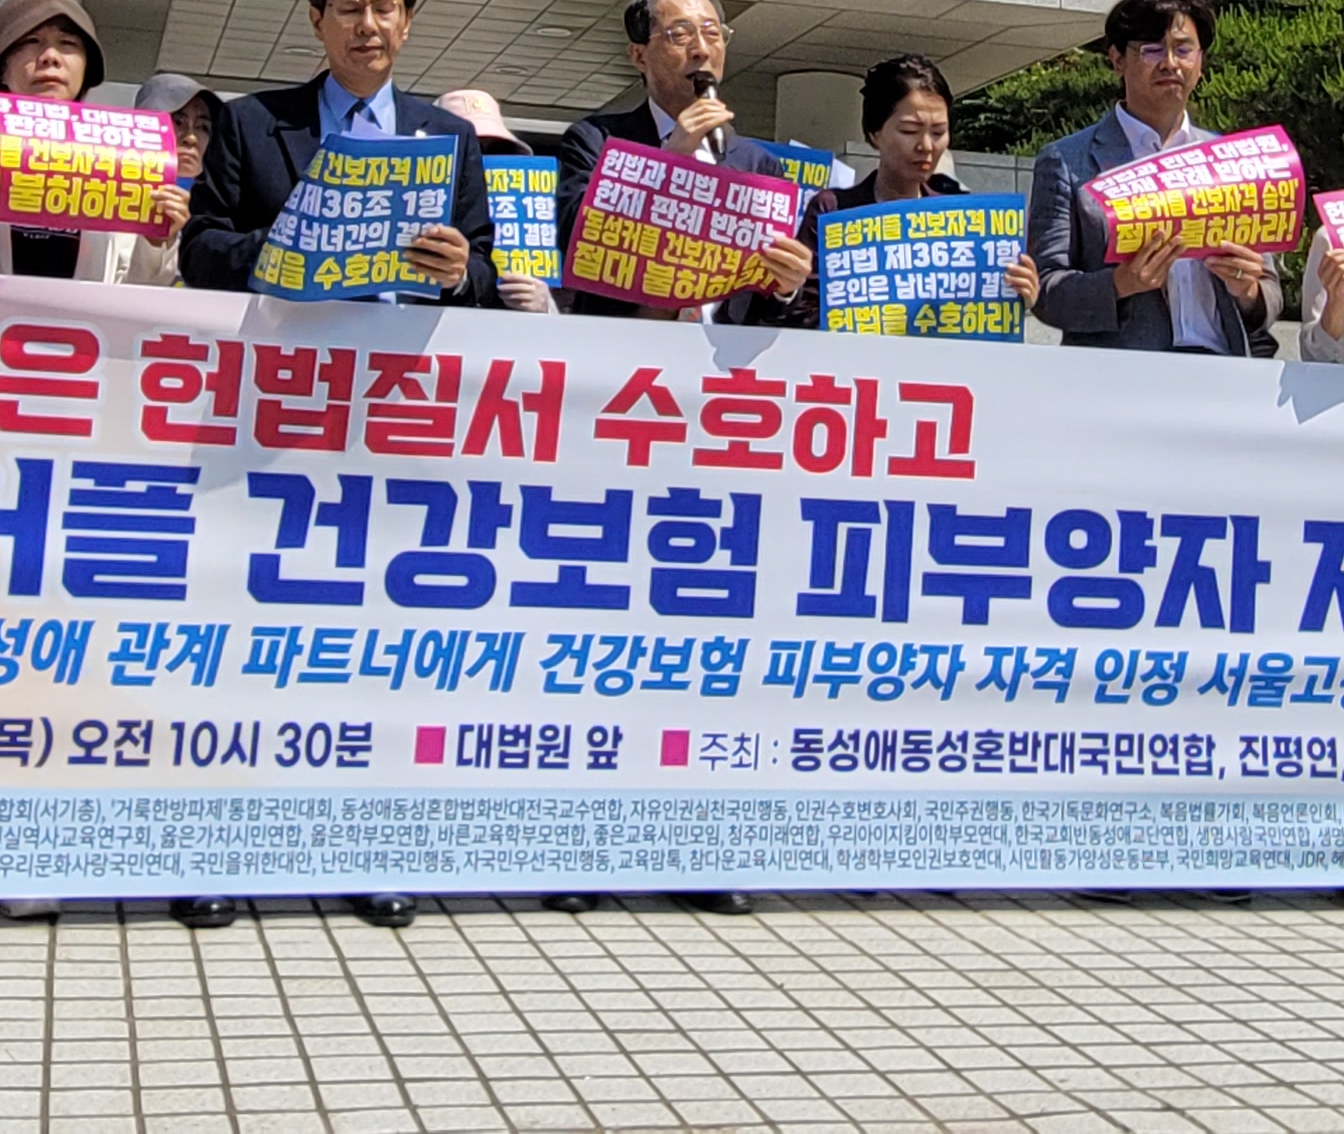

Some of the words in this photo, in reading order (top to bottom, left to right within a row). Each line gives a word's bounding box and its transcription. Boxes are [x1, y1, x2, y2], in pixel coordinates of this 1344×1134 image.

[4, 113, 66, 141] 판례
[74, 122, 163, 150] 반하는
[28, 138, 117, 181] 건보자격
[324, 152, 411, 187] 건보자격
[415, 155, 454, 185] NO!
[402, 189, 446, 217] 1항
[600, 148, 665, 191] 헌법과
[670, 166, 721, 207] 민법,
[725, 182, 793, 225] 대법원,
[593, 180, 647, 219] 헌재
[650, 194, 705, 235] 판례
[300, 219, 392, 252] 남녀간의
[825, 213, 901, 249] 동성커플
[906, 209, 986, 239] 건보자격
[991, 209, 1024, 237] NO!
[1180, 211, 1296, 248] 불허하라!
[663, 232, 743, 273] 건보자격
[825, 247, 878, 278] 헌법
[884, 241, 976, 270] 제36조
[982, 240, 1022, 267] 1항
[826, 275, 889, 306] 혼인은
[894, 272, 976, 300] 남녀간의
[828, 304, 907, 335] 헌법을
[914, 302, 1020, 334] 수호하라!
[138, 330, 568, 464] 헌법질서
[592, 364, 978, 480] 수호하고
[246, 470, 764, 620] 건강보험
[795, 496, 1273, 635] 피부양자
[108, 623, 231, 687] 관계
[241, 626, 525, 694] 파트너에게
[538, 634, 750, 697] 건강보험
[763, 640, 966, 701] 피부양자
[976, 645, 1077, 705] 자격
[1093, 649, 1189, 707] 인정
[68, 719, 154, 766] 오전
[170, 720, 260, 767] 10시
[275, 722, 373, 767] 30분
[457, 724, 572, 769] 대법원
[586, 726, 623, 770] 앞
[790, 727, 1226, 780] 동성애동성혼반대국민연합,
